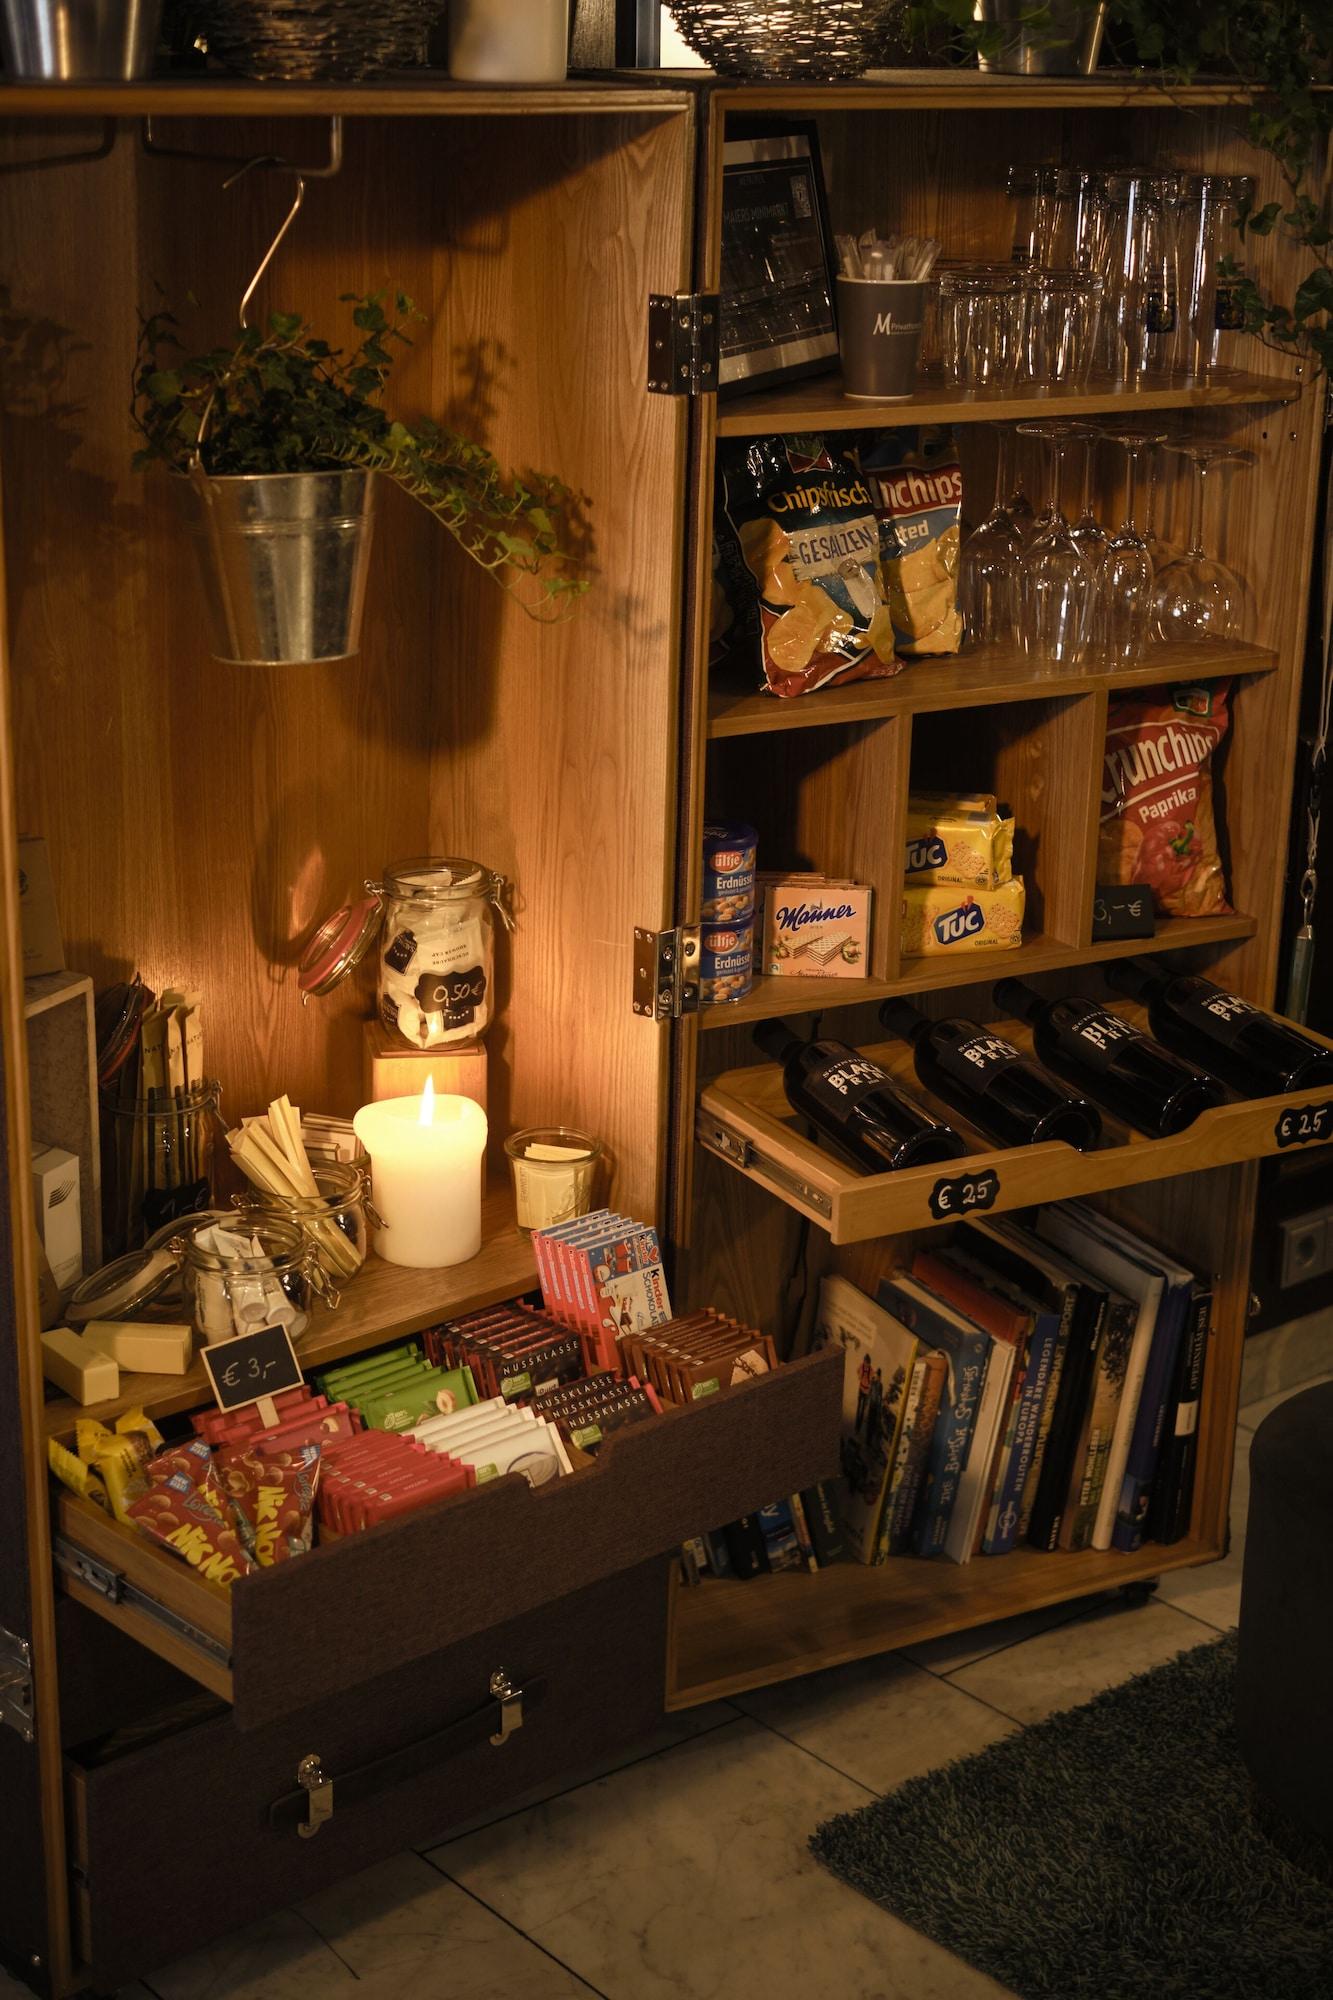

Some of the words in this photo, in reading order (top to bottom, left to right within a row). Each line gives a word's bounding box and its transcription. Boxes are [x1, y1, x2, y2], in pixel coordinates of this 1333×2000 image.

[799, 525, 874, 565] GESALZEN
[1138, 787, 1197, 824] Paprika
[776, 904, 857, 932] Manner
[938, 911, 980, 943] TUC
[1298, 1109, 1328, 1135] 25
[962, 1179, 993, 1205] 25
[1060, 1291, 1077, 1337] SPORT
[221, 1361, 240, 1386] €
[503, 1340, 579, 1376] NUSSKLASSE
[1033, 1337, 1053, 1400] LEGENDÄRE
[536, 1375, 614, 1411] NUSSKLASSE
[552, 1384, 630, 1420] NUSSKLASSE
[1024, 1385, 1034, 1398] IN
[568, 1392, 647, 1429] NUSSKLASSE
[1015, 1404, 1030, 1444] EUROPA
[1014, 1404, 1040, 1491] WANDERROUTEN
